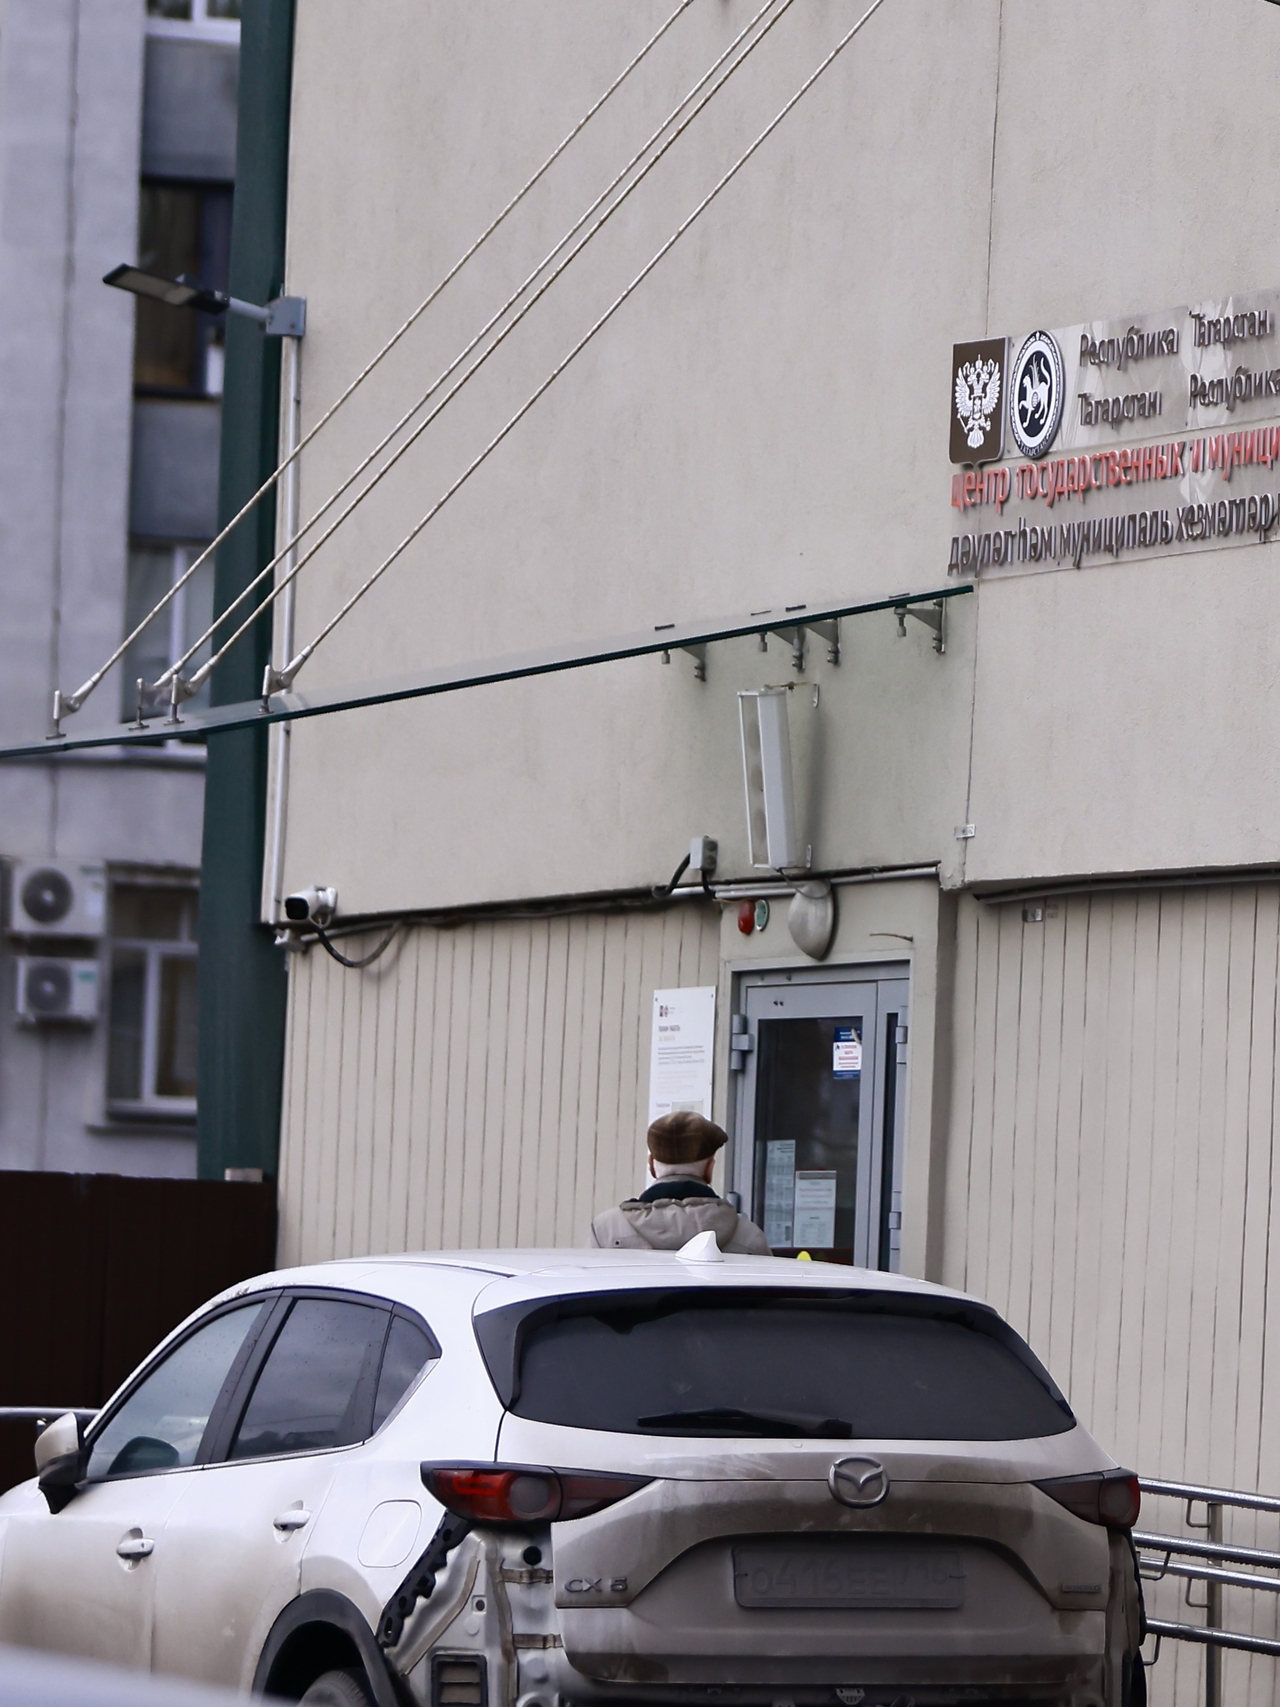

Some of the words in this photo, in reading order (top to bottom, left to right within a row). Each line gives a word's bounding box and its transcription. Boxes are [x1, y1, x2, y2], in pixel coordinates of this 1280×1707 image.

[1079, 325, 1180, 371] Республика
[1190, 309, 1272, 350] Татарстан
[1077, 390, 1163, 429] Татарстан
[951, 466, 1011, 515] центр
[1016, 441, 1186, 507] государственных
[1190, 438, 1205, 473] и
[1018, 516, 1057, 563] һәм
[1060, 509, 1174, 569] муниципаль
[564, 1578, 603, 1593] CX
[610, 1577, 628, 1592] 5
